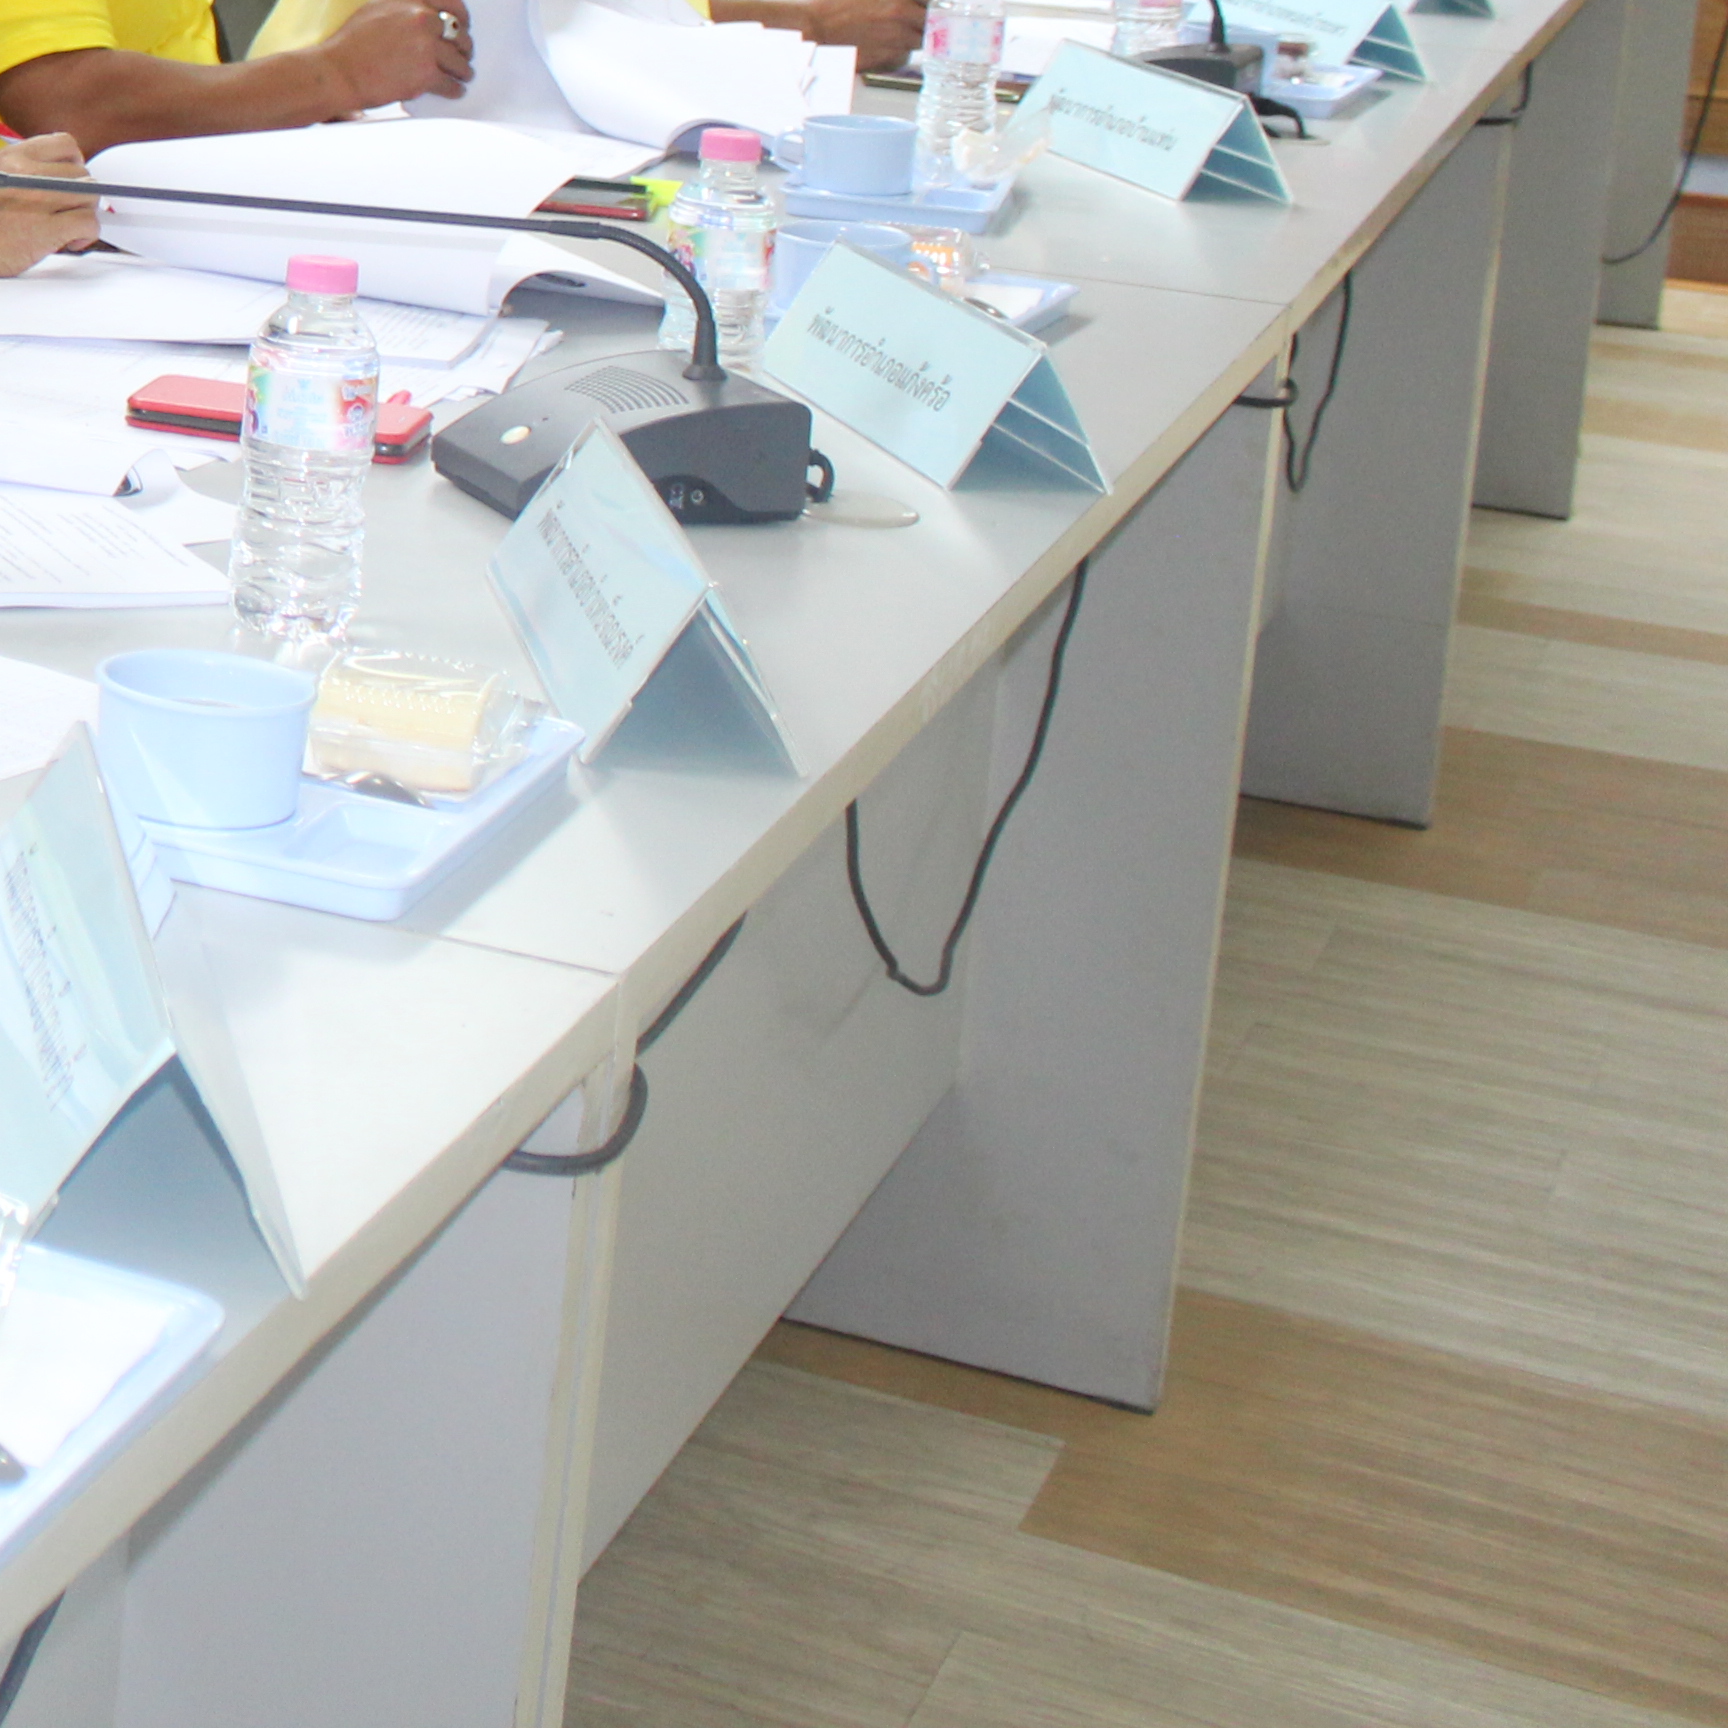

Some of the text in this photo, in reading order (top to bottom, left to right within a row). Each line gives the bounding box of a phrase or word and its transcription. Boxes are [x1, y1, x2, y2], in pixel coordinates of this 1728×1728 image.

[807, 305, 953, 412] พัฒนาการอำเภอแก้งคร้อ
